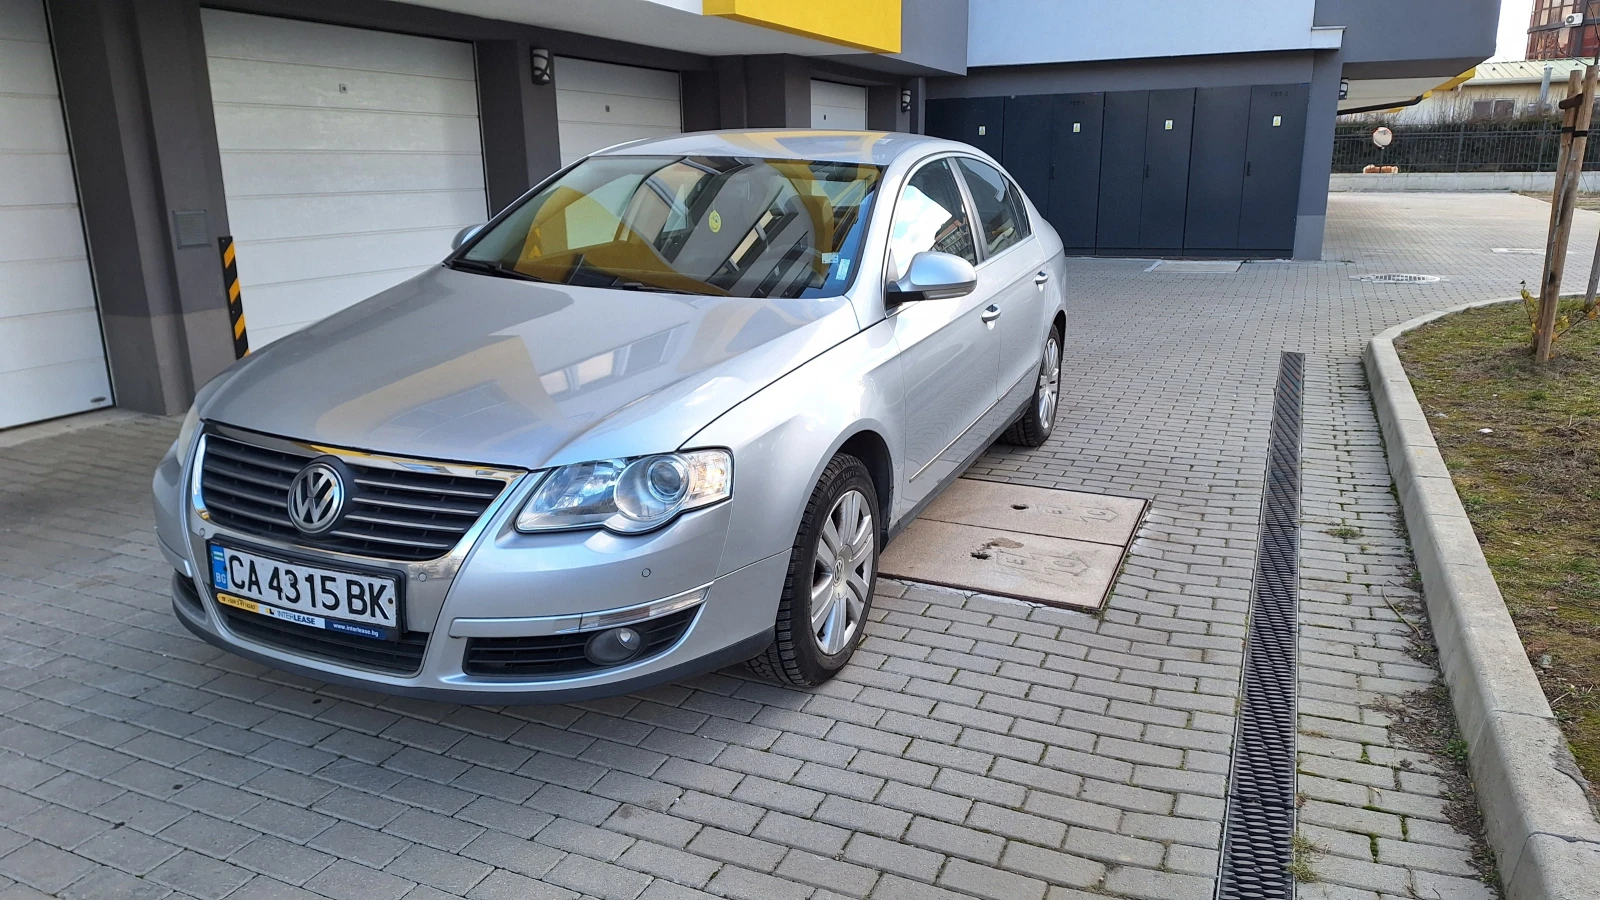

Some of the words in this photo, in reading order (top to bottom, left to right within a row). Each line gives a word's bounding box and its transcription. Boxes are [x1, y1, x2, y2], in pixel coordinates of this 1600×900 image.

[290, 466, 341, 529] VW
[215, 572, 227, 584] BG
[229, 555, 262, 595] CA
[268, 566, 340, 611] 4315
[346, 579, 390, 620] BK
[277, 610, 316, 625] INTERLEASE
[332, 622, 379, 638] www.interlease.bg
